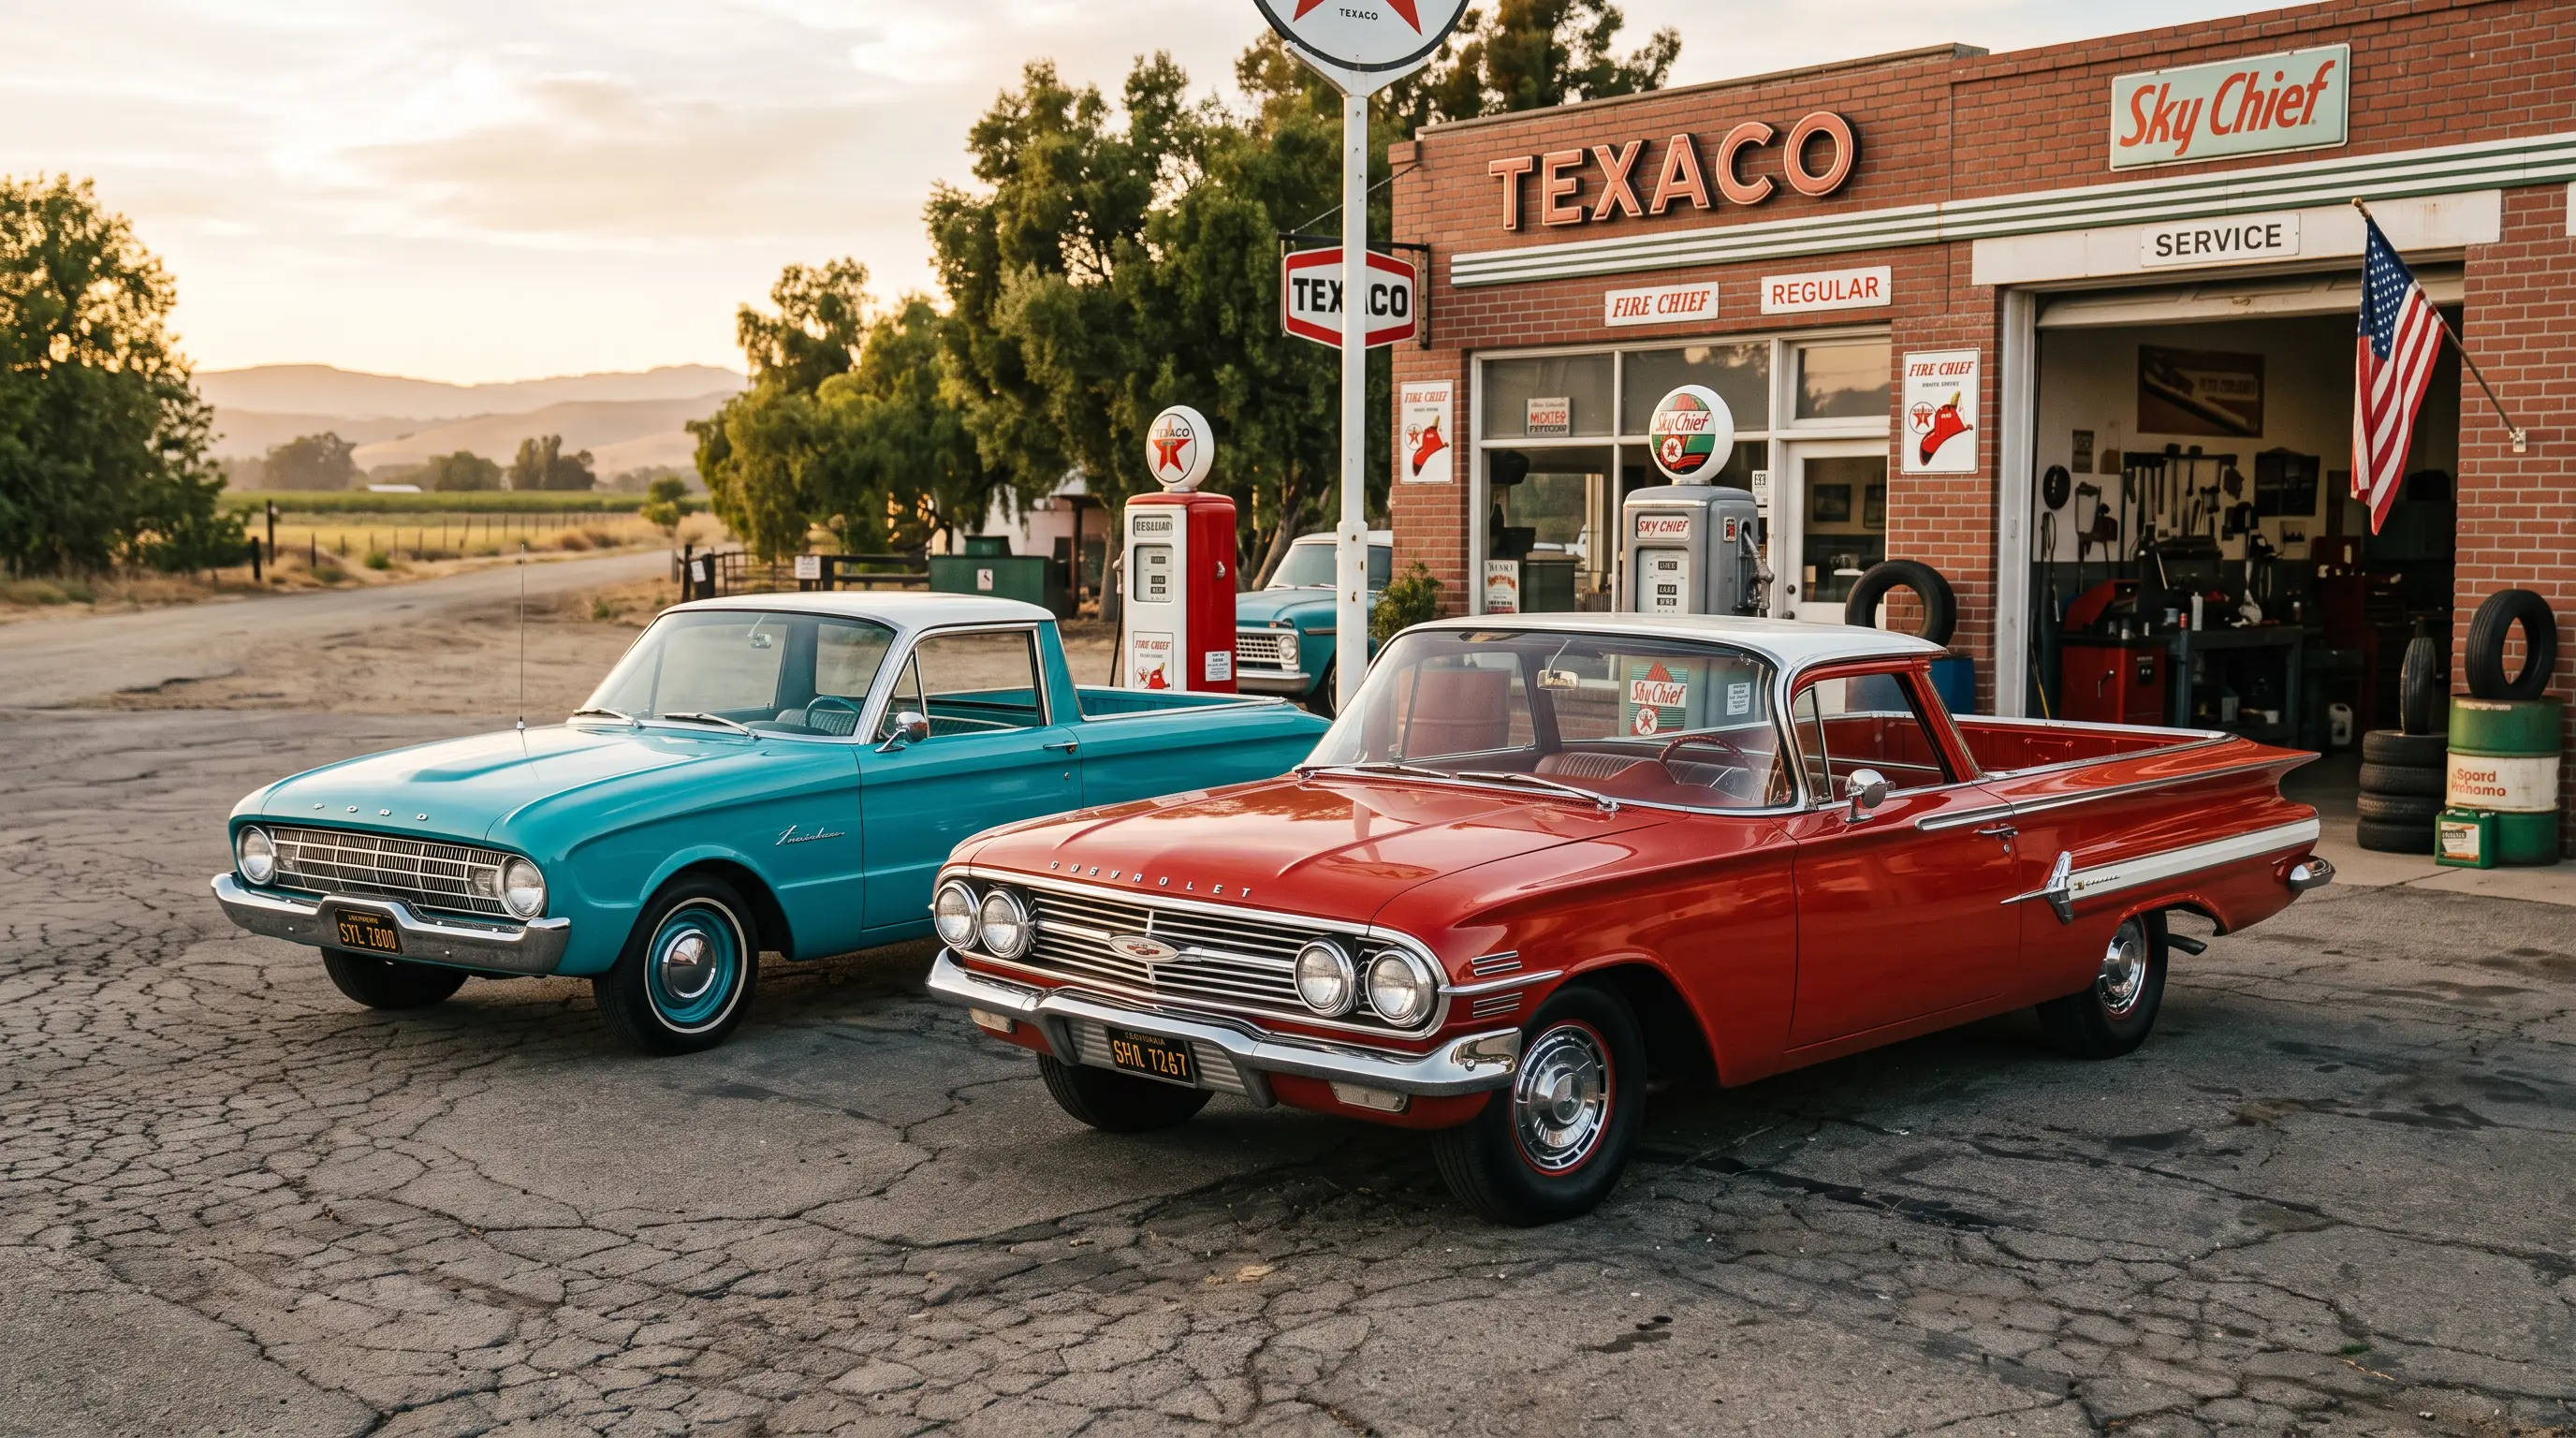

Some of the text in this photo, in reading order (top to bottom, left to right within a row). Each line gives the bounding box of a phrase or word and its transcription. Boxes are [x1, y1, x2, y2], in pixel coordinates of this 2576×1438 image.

[1339, 7, 1379, 21] TEXACO
[2118, 59, 2336, 157] Sky Chief
[1488, 110, 1859, 232] TEXACO
[2155, 223, 2283, 257] SERVICE
[1292, 277, 1408, 318] TEXCO
[1612, 290, 1710, 318] FIRE CHIEF
[1771, 275, 1880, 306] REGULAR
[1909, 360, 1974, 377] FIRE CHIEF
[1656, 412, 1711, 435] Sky Chief
[1638, 520, 1689, 536] SKY CHIEF
[1652, 682, 1687, 706] Chief
[1148, 1048, 1187, 1077] 7267
